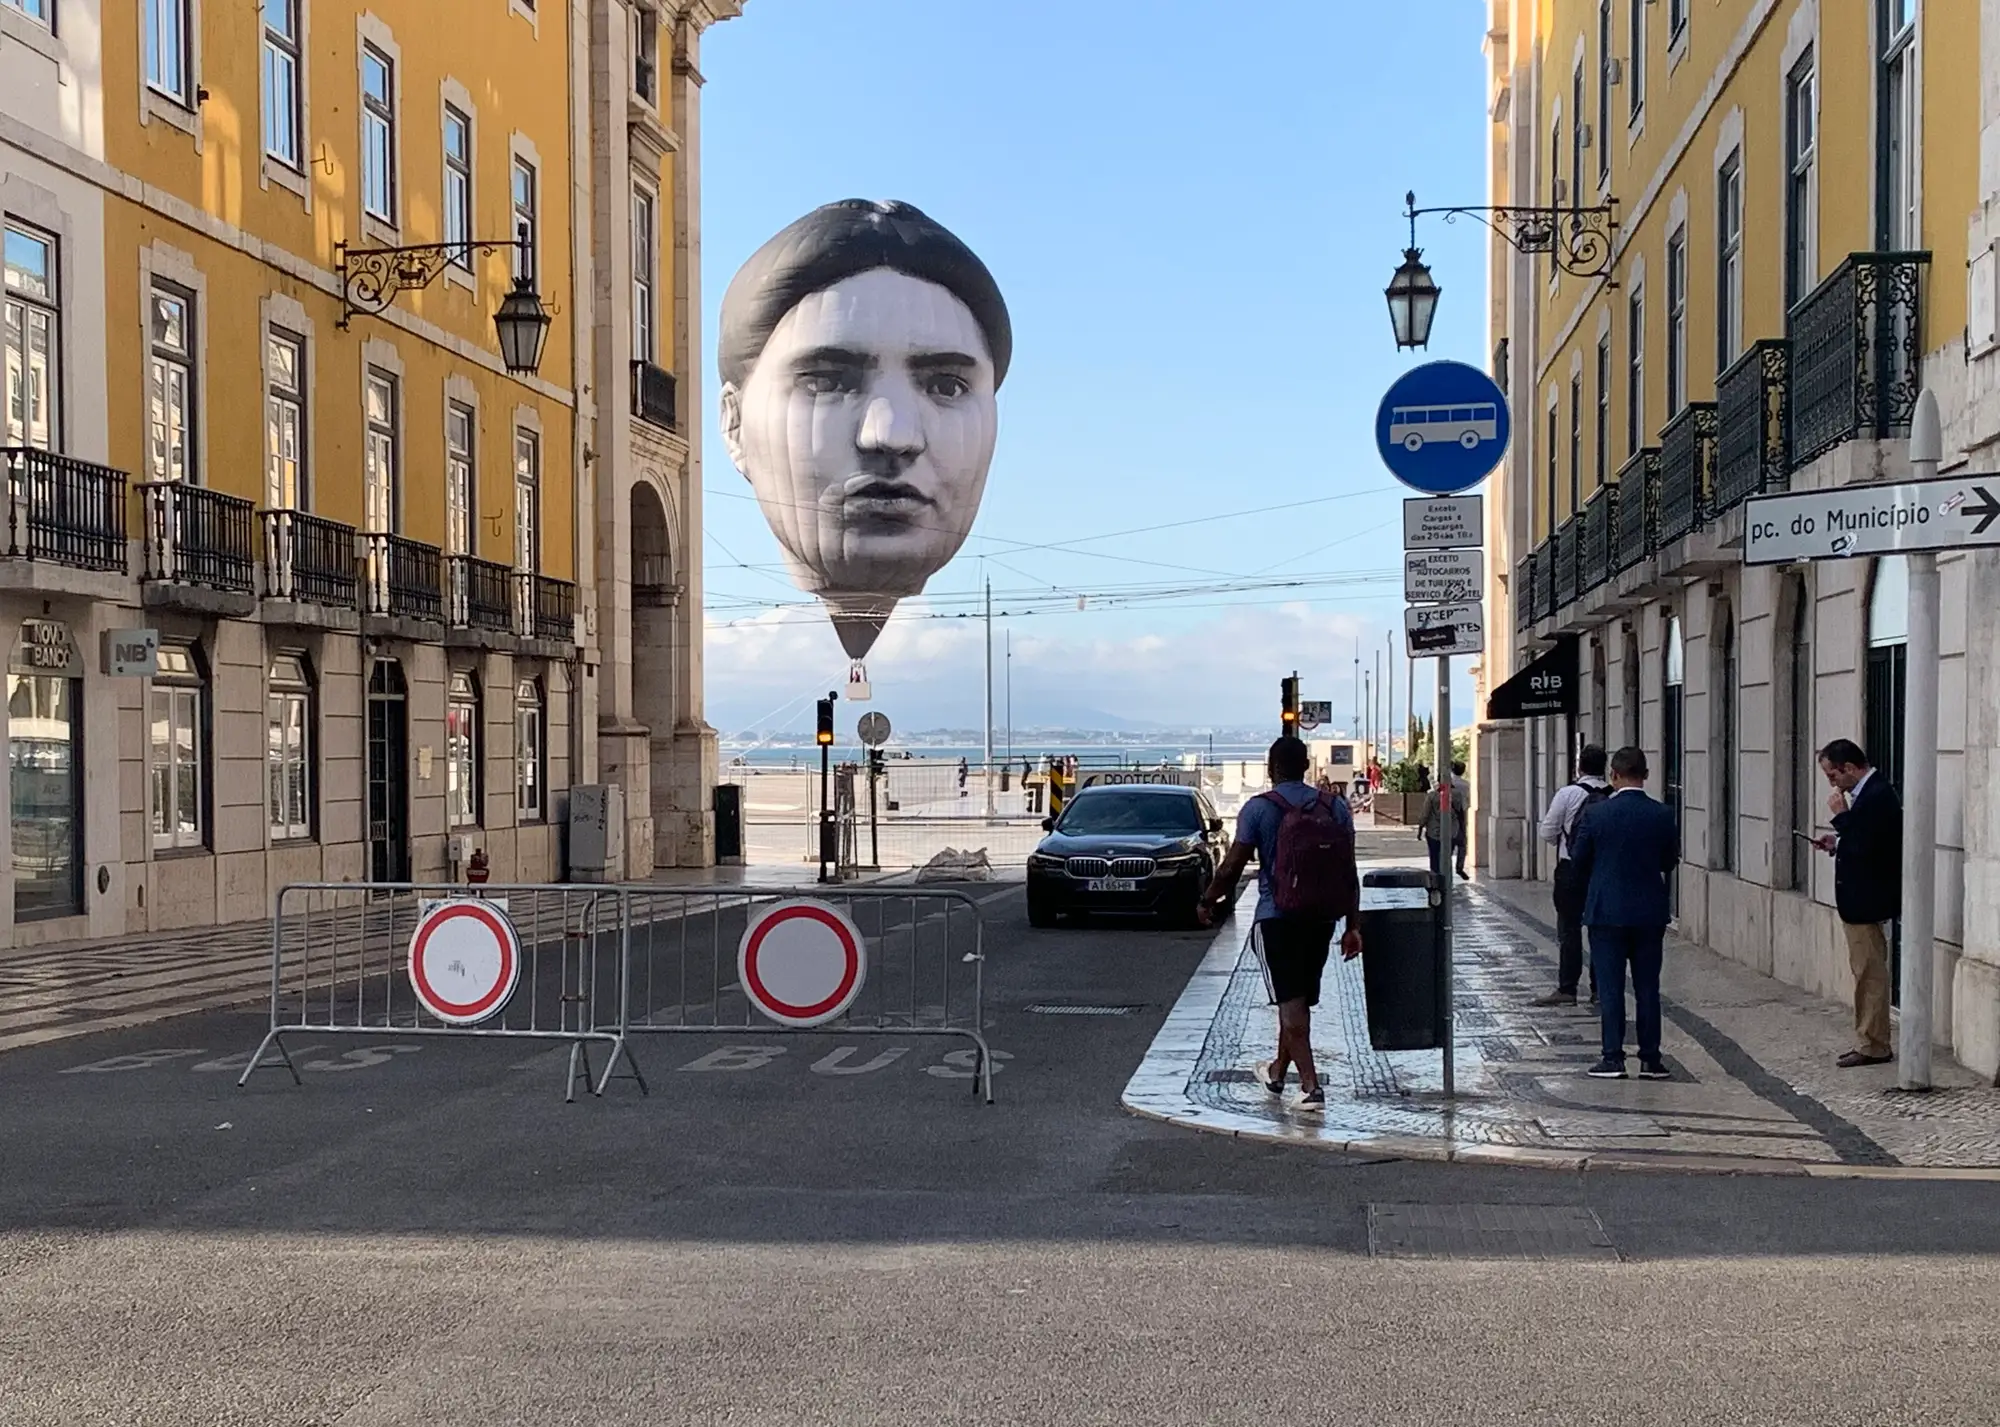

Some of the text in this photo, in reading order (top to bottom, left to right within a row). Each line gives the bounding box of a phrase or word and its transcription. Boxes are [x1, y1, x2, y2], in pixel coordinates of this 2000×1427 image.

[1423, 514, 1453, 523] Cargas
[1752, 502, 1930, 543] pc. do Município
[1421, 523, 1464, 533] Descargas
[1428, 555, 1460, 564] EXCETO
[1416, 566, 1471, 577] AUTOCARROS
[1415, 579, 1426, 588] DE
[1467, 578, 1472, 587] E
[1406, 591, 1441, 600] SERVIÇO
[34, 646, 71, 667] BANCO
[116, 643, 147, 663] NB
[1530, 672, 1562, 689] RIB
[677, 1045, 1015, 1079] BUS
